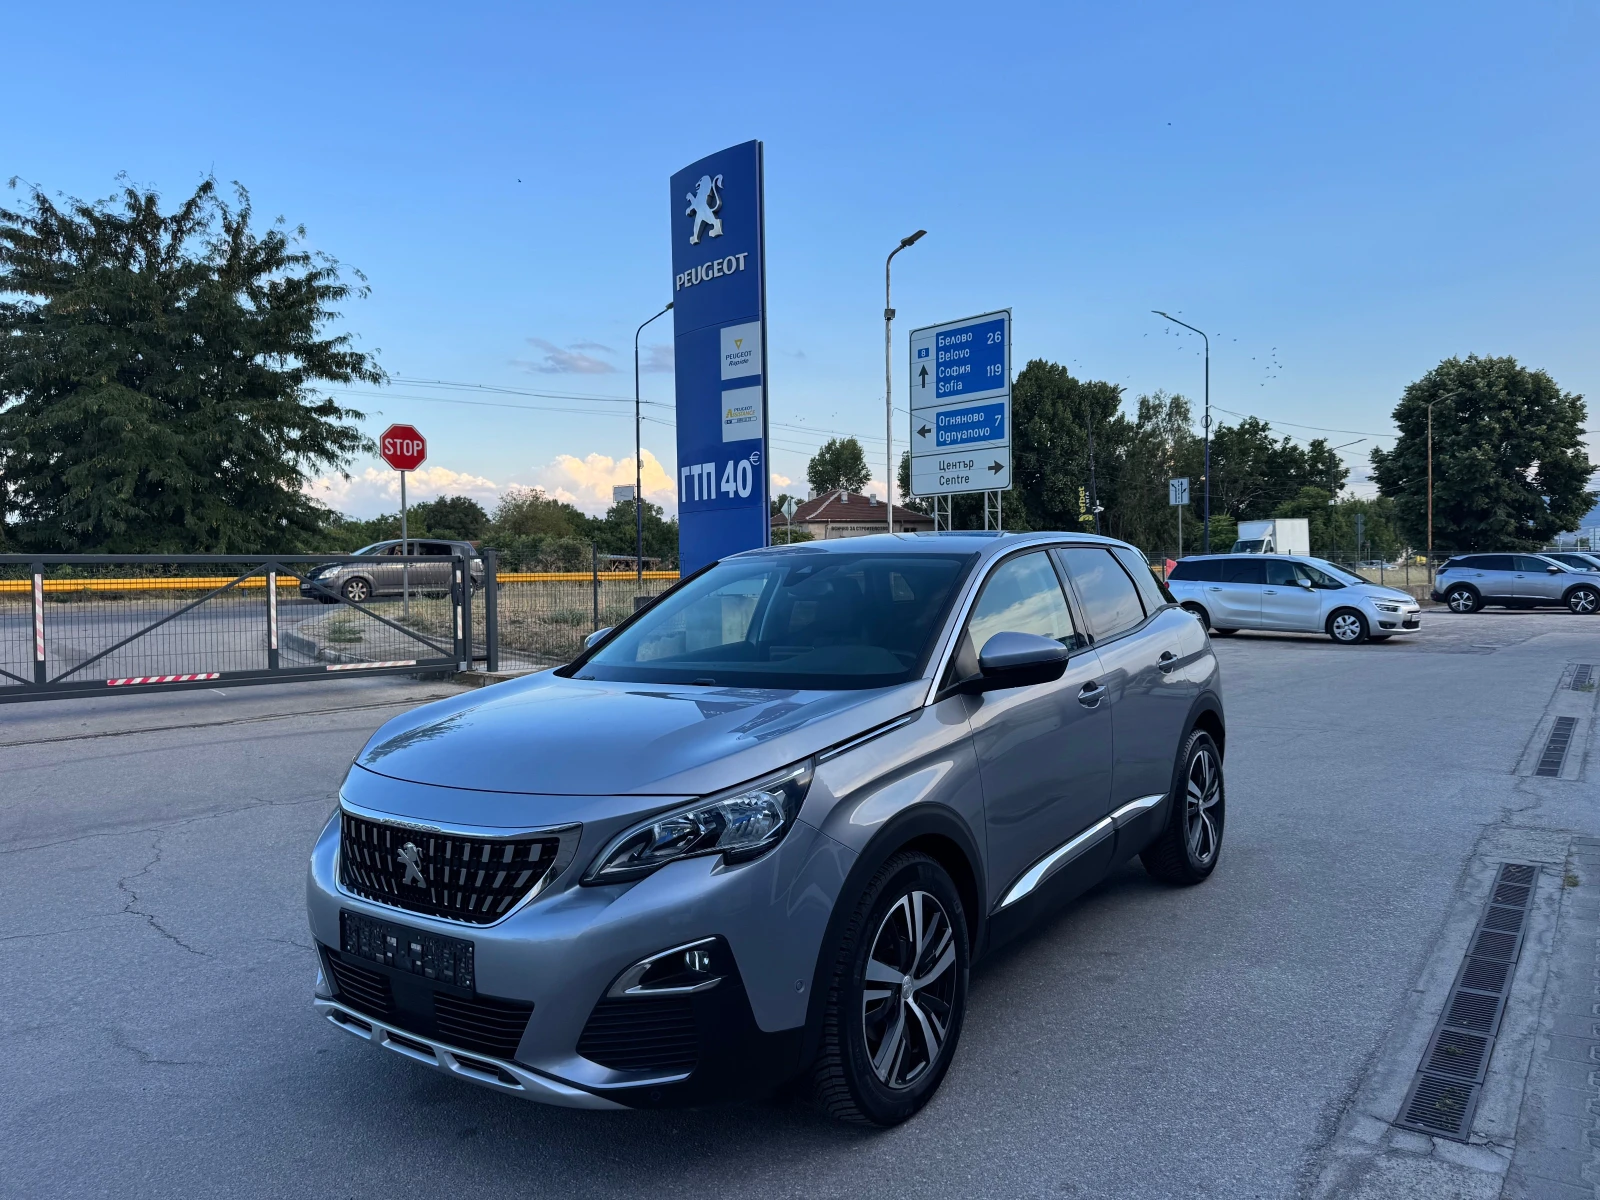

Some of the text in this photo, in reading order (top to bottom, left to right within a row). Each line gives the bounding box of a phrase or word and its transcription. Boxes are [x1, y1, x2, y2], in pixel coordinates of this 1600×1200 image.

[676, 252, 748, 291] PEUGEOT
[938, 331, 1002, 347] Белово 26
[725, 350, 752, 360] PEUGEOT
[921, 349, 926, 357] 8
[938, 348, 970, 362] Belovo
[938, 363, 1002, 378] София 119
[938, 380, 963, 393] Sofia
[938, 412, 1002, 427] Огняново 7
[938, 427, 990, 443] Ognyanovo
[384, 438, 423, 457] STOP
[938, 459, 974, 472] Център
[681, 462, 716, 503] ГТП
[938, 474, 970, 486] Centre
